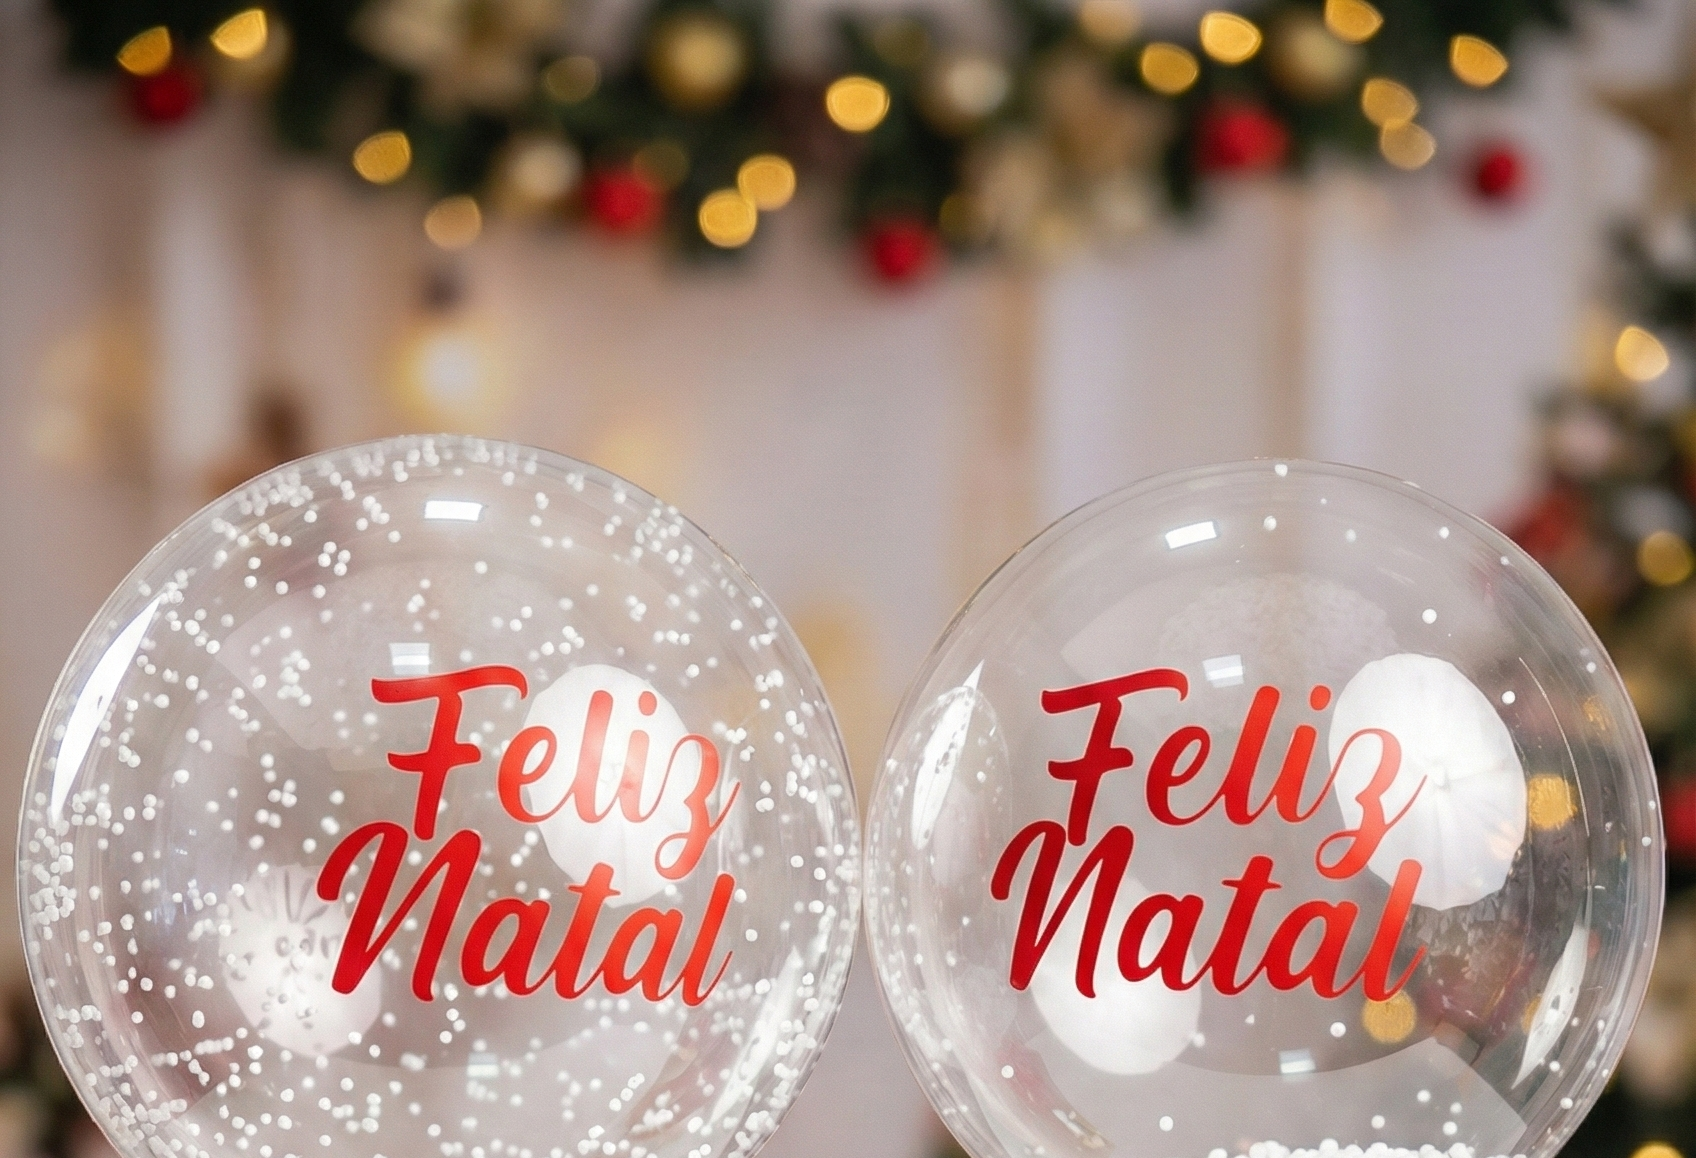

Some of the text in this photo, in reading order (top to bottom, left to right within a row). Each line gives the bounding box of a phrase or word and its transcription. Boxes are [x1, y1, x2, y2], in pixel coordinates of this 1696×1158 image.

[371, 664, 741, 880] Feliz
[1041, 668, 1428, 880] Feliz
[316, 820, 736, 1007] Natal
[990, 819, 1428, 1002] Natal
